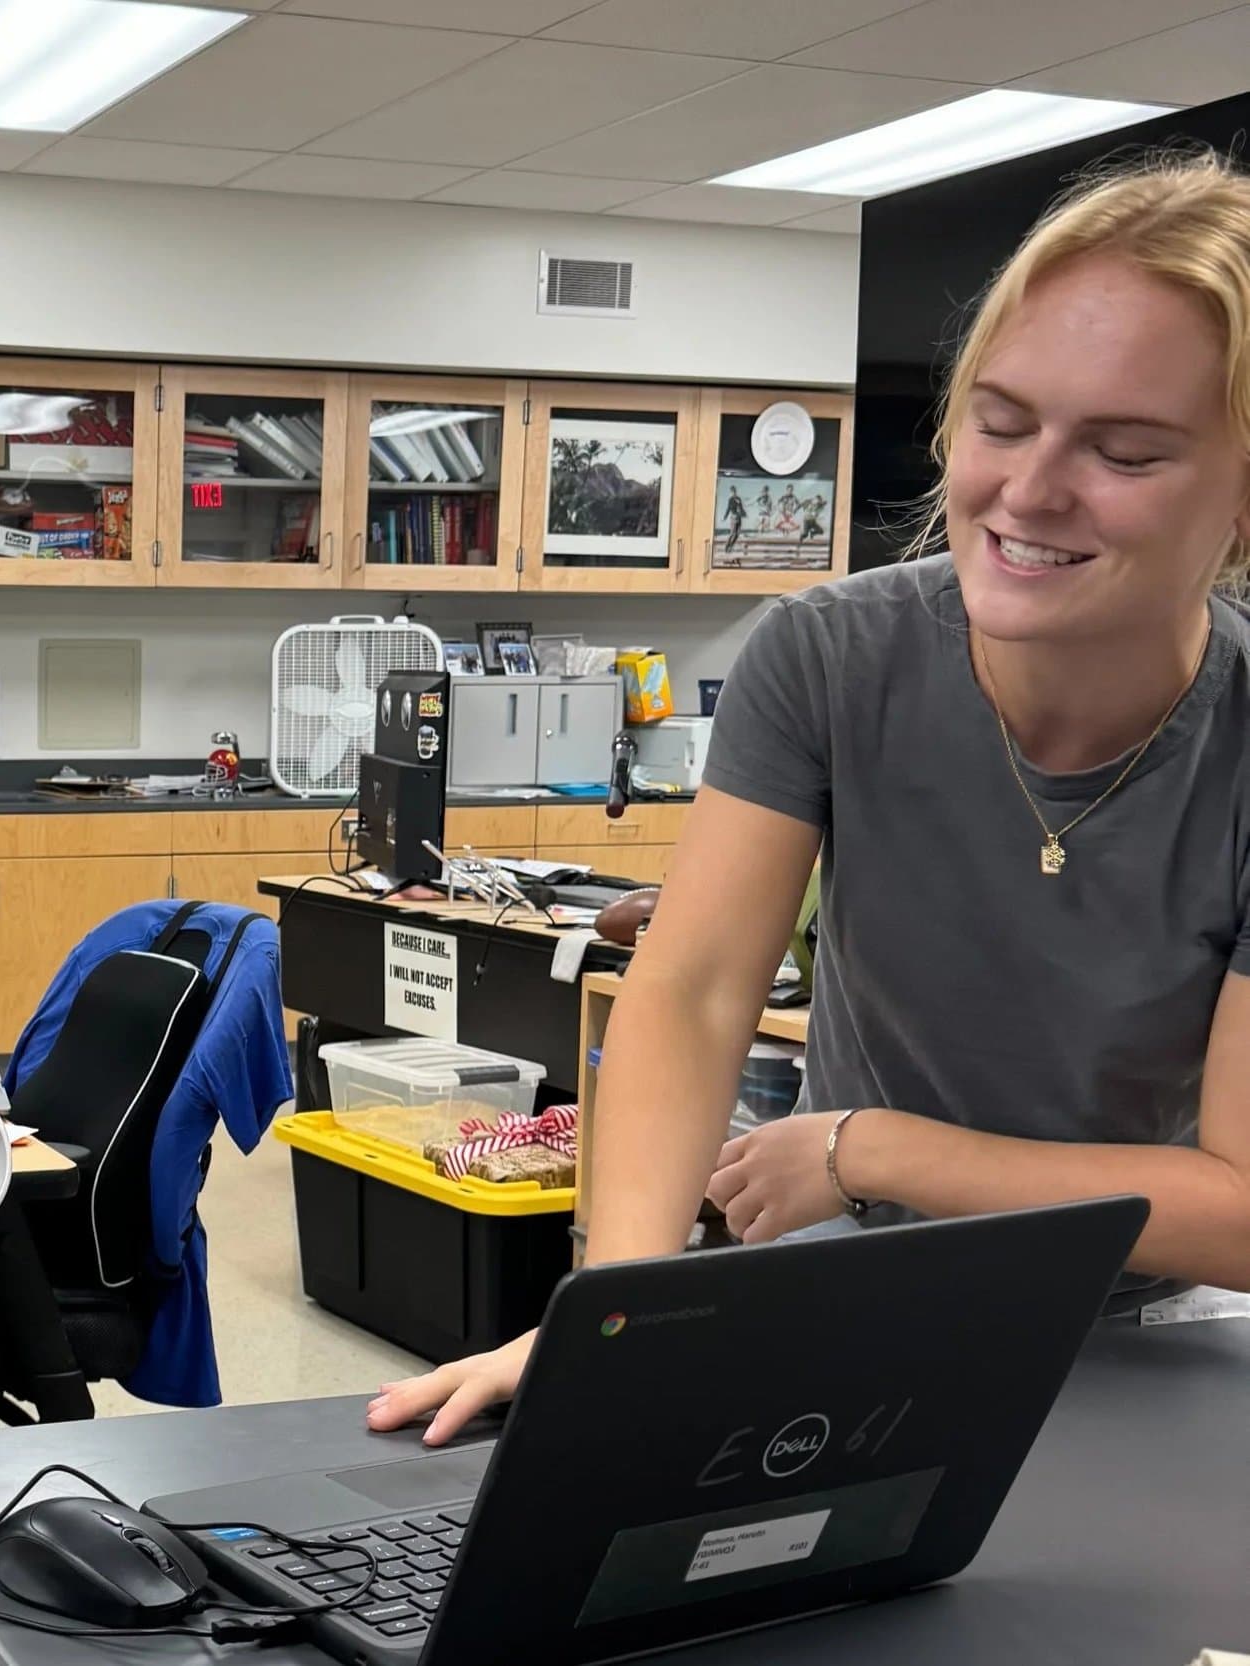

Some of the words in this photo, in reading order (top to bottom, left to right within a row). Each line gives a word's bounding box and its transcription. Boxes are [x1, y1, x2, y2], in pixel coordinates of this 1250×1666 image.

[391, 930, 422, 952] BECAUSE
[422, 937, 426, 951] I
[389, 963, 393, 977] I
[393, 964, 409, 981] WILL
[410, 968, 424, 984] NOT
[425, 972, 453, 992] ACCEPT
[404, 989, 437, 1011] EXCUSES.
[696, 1426, 755, 1487] E
[845, 1397, 913, 1457] 61
[770, 1433, 819, 1457] DELL
